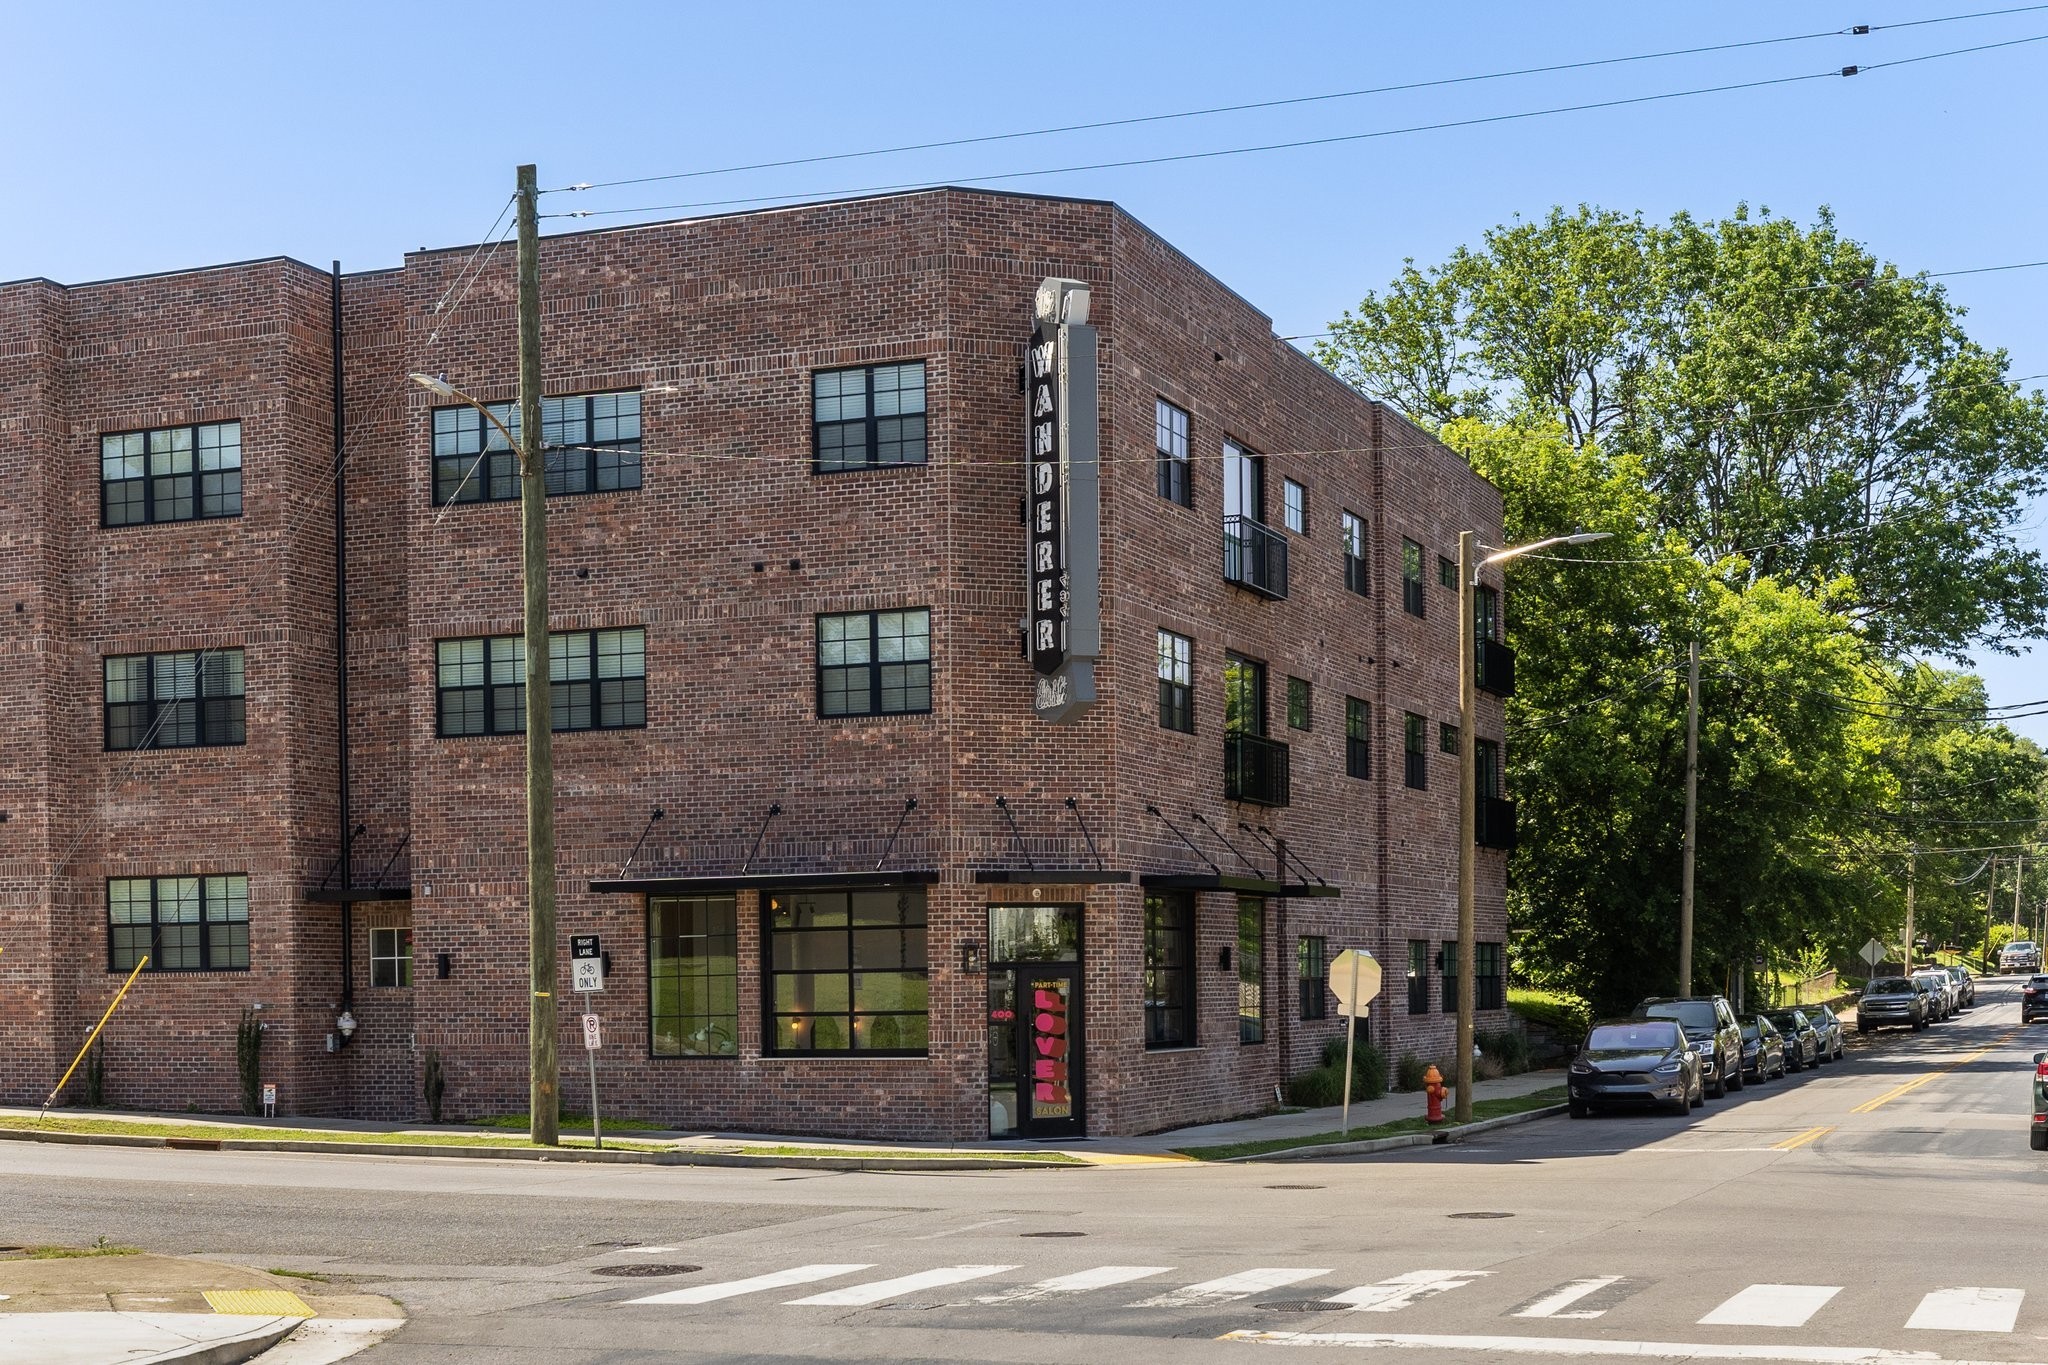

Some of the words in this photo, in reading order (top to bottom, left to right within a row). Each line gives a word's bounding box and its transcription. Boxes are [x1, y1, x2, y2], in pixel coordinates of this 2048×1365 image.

[1031, 341, 1055, 651] WANDERER
[577, 938, 593, 946] RIGHT
[579, 948, 593, 956] LANE
[579, 977, 598, 988] ONLY
[1035, 989, 1065, 1102] LOVER
[1036, 1106, 1068, 1116] SALON
